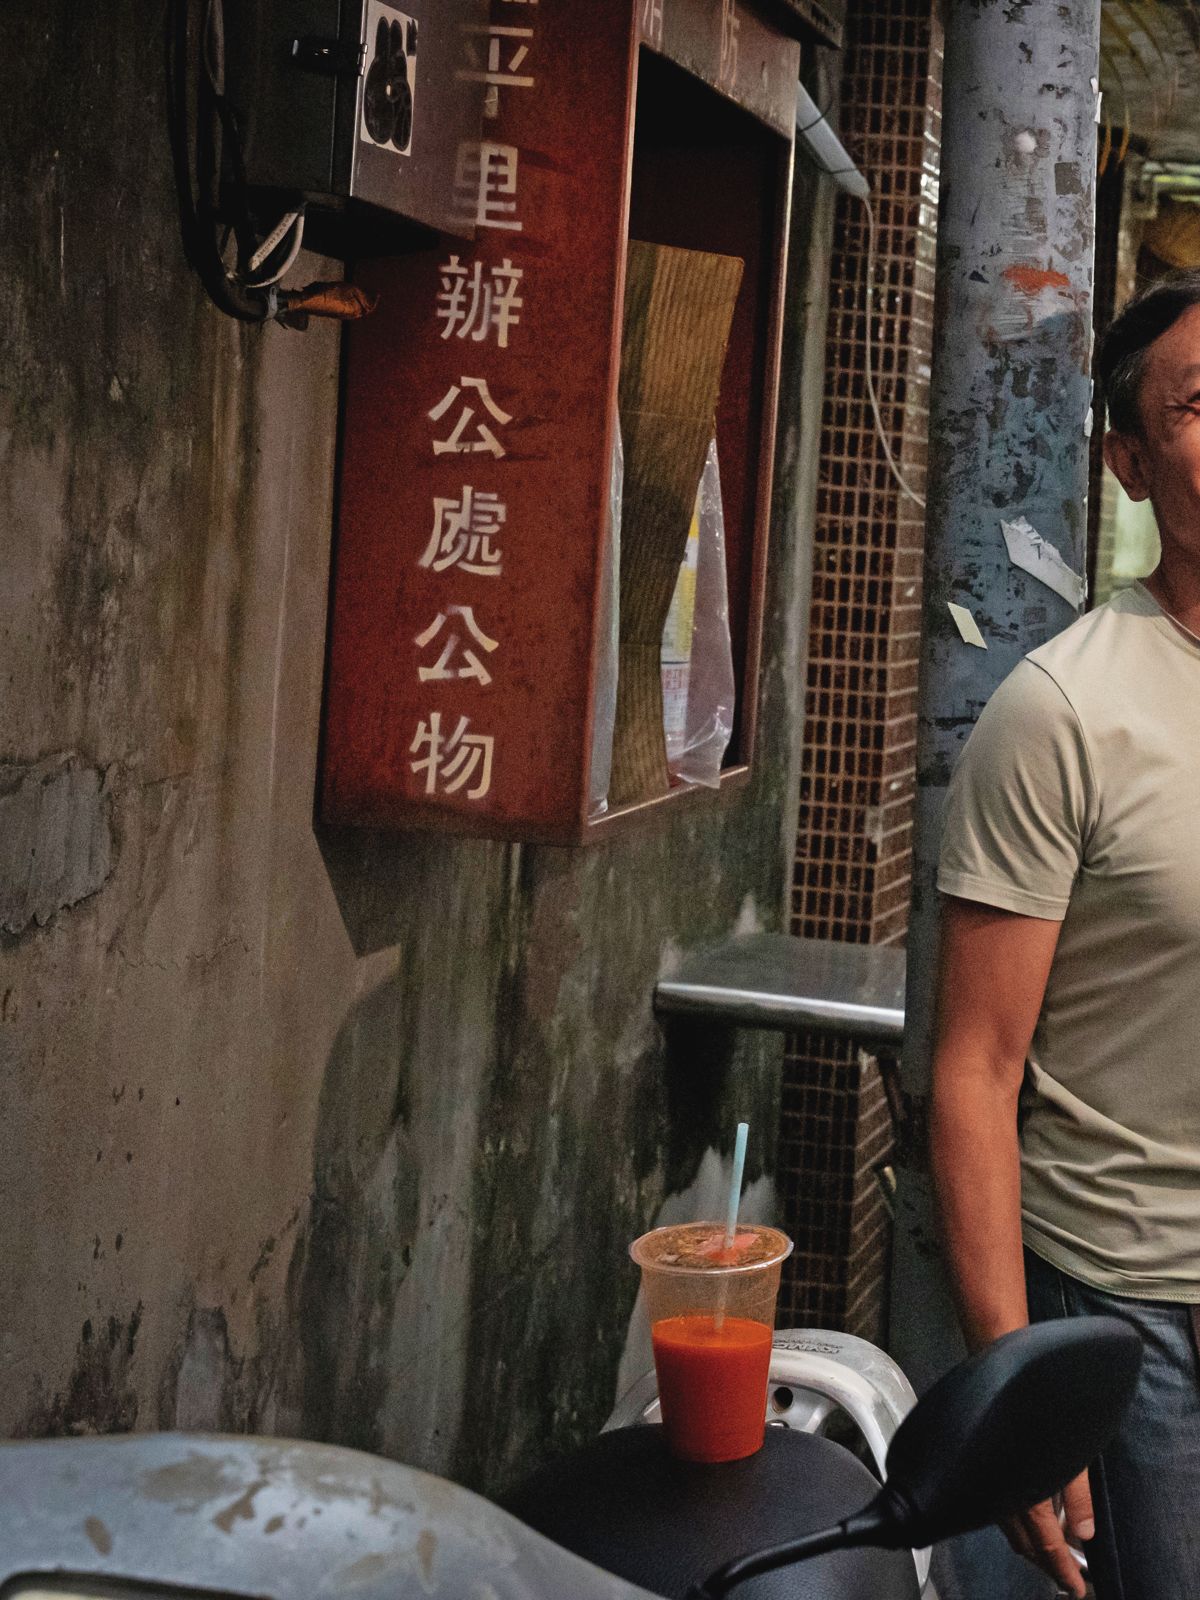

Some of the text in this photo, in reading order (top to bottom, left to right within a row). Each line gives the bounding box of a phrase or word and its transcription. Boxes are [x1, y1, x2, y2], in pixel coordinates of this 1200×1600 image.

[408, 0, 539, 800] 平里辦公處公物
